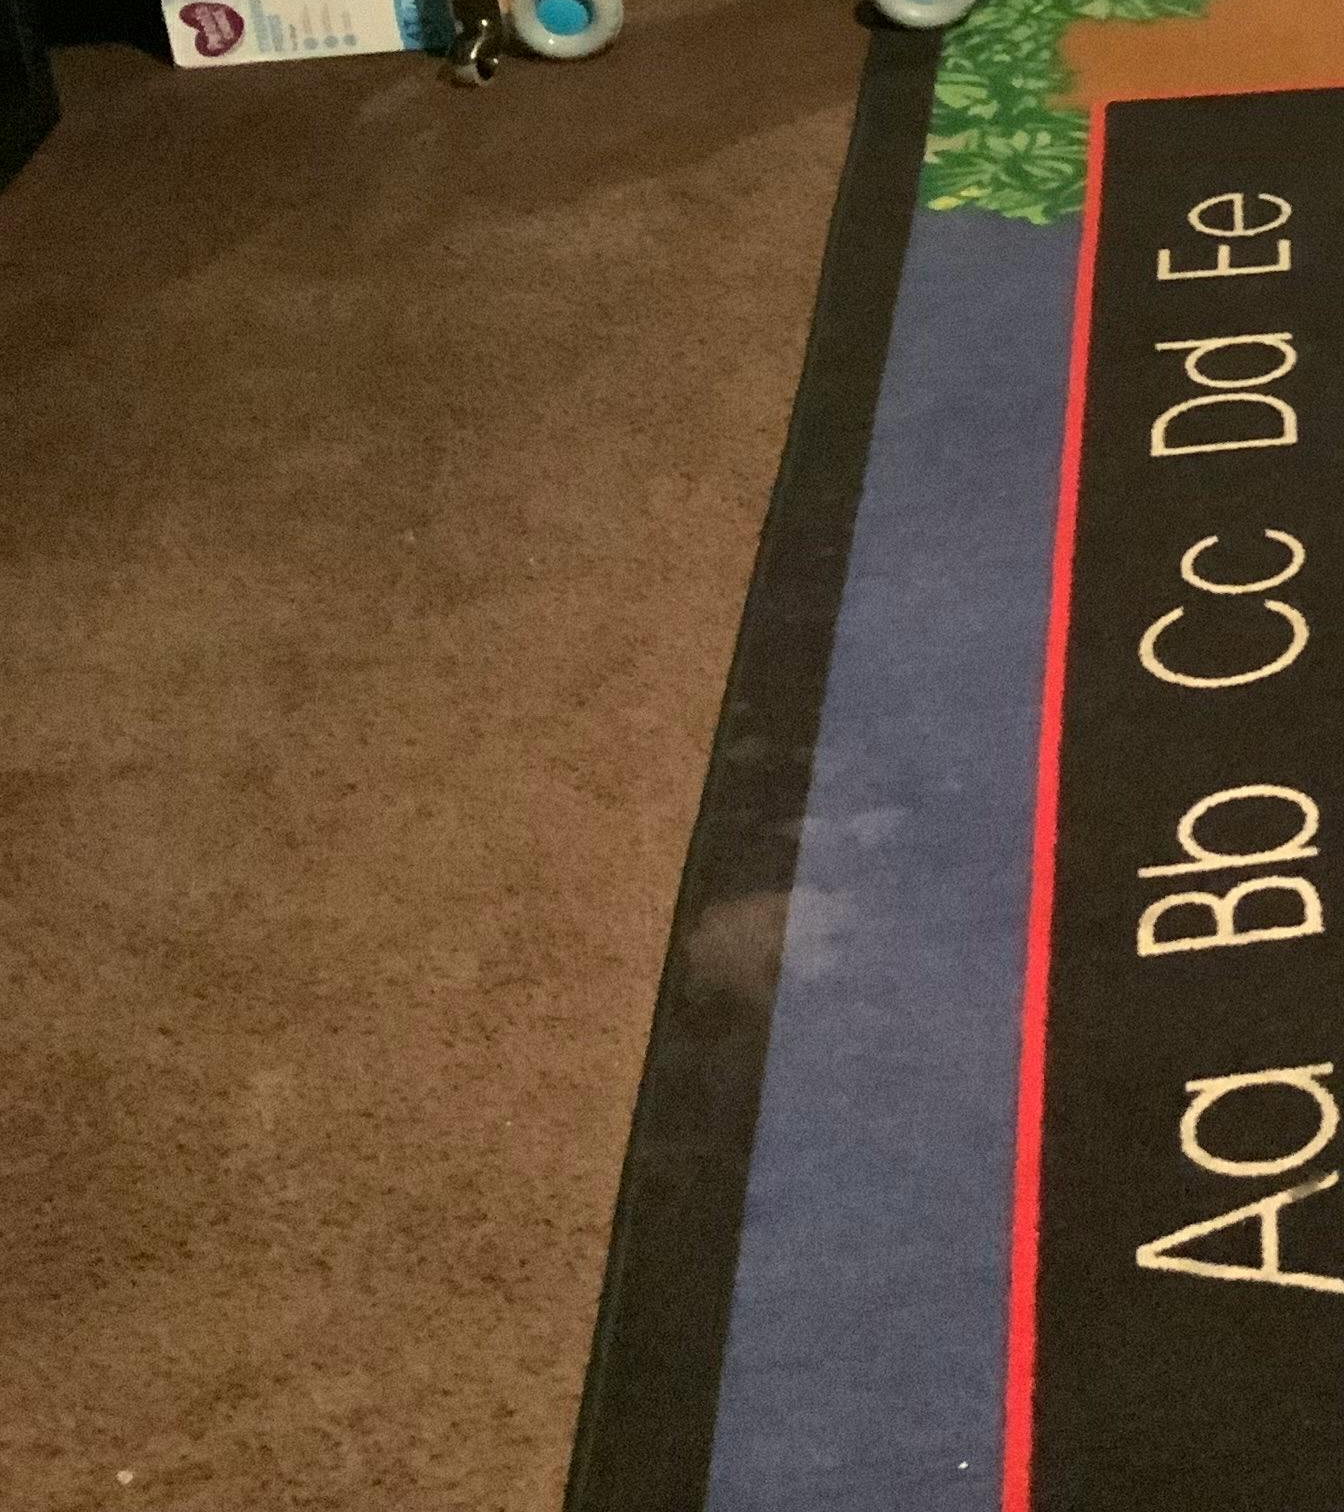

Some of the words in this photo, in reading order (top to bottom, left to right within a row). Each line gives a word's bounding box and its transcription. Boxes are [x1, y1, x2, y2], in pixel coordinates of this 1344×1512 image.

[1157, 193, 1292, 280] Ee
[1150, 332, 1298, 457] Dd
[1139, 529, 1309, 688] Cc
[1137, 784, 1324, 957] Bb
